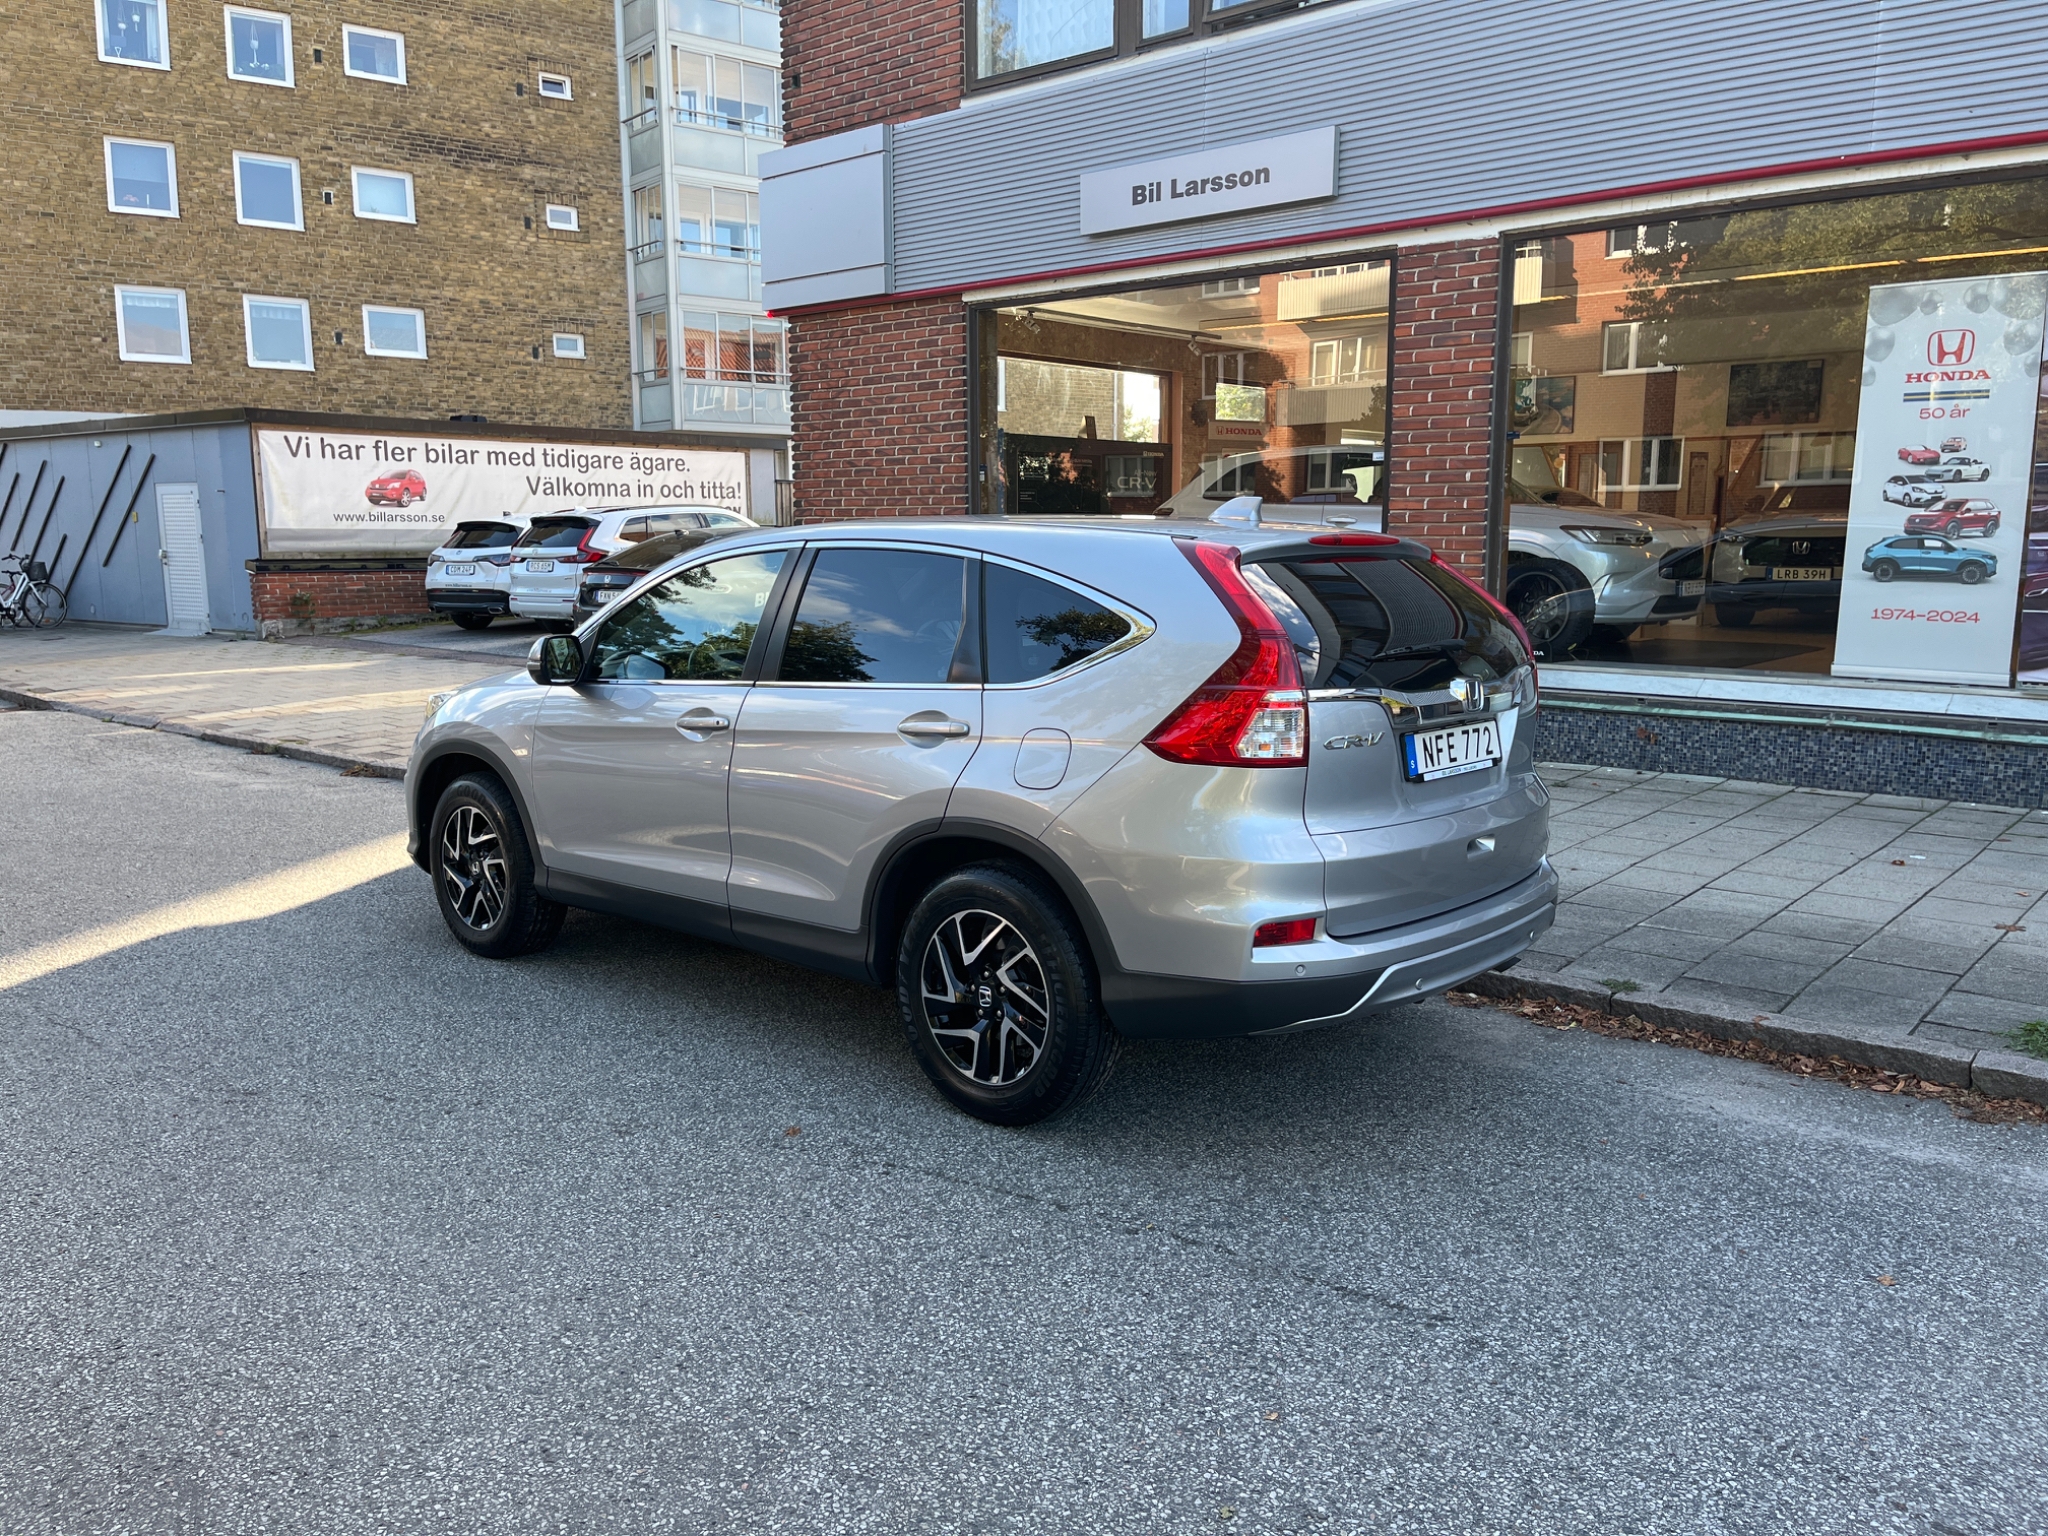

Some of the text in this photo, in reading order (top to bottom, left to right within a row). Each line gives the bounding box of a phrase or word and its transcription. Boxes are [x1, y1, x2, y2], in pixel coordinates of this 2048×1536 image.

[1132, 167, 1270, 206] Bil Larsson
[1904, 369, 1991, 384] HONDA
[1919, 403, 1971, 420] 50 år
[1225, 427, 1262, 436] HONDA
[283, 435, 690, 476] Vi har fler bilar med tidigare ägare.
[526, 475, 742, 500] Välkomna in och titta!
[1117, 476, 1157, 489] CR-V
[333, 511, 446, 523] www.billarsson.se
[1776, 569, 1826, 579] LRB 39H
[1870, 608, 1981, 624] 1974-2024
[1323, 731, 1385, 750] CR-V
[1422, 725, 1494, 769] NFE 772
